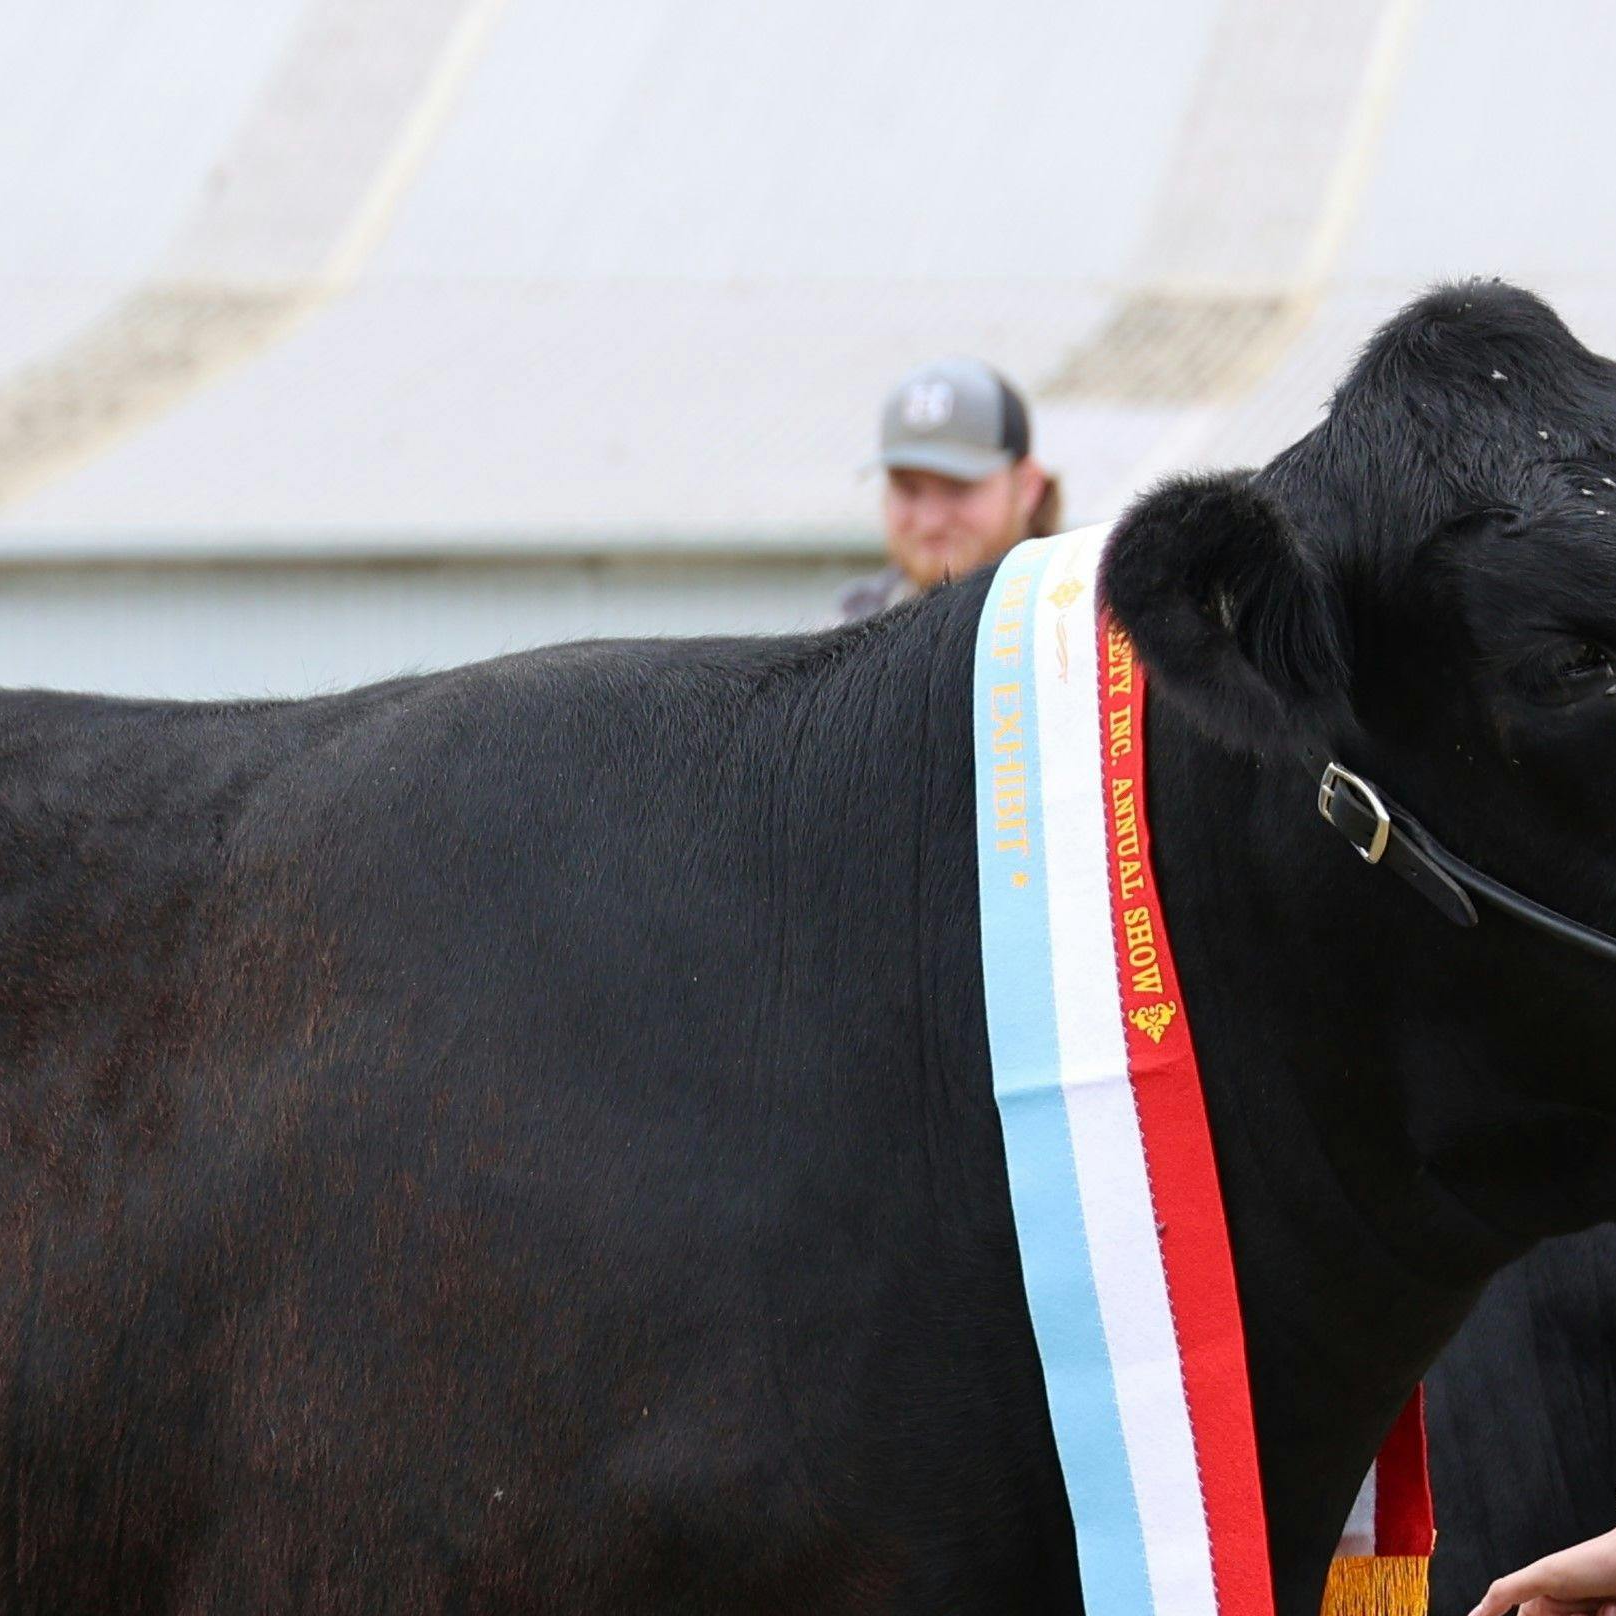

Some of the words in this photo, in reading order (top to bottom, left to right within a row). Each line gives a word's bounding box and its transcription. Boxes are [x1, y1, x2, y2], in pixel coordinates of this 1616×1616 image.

[992, 575, 1032, 669] BEEF
[991, 682, 1029, 858] EXHIBIT
[1109, 704, 1132, 767] INC.
[1111, 778, 1145, 901] ANNUAL
[1123, 906, 1164, 995] SHOW
